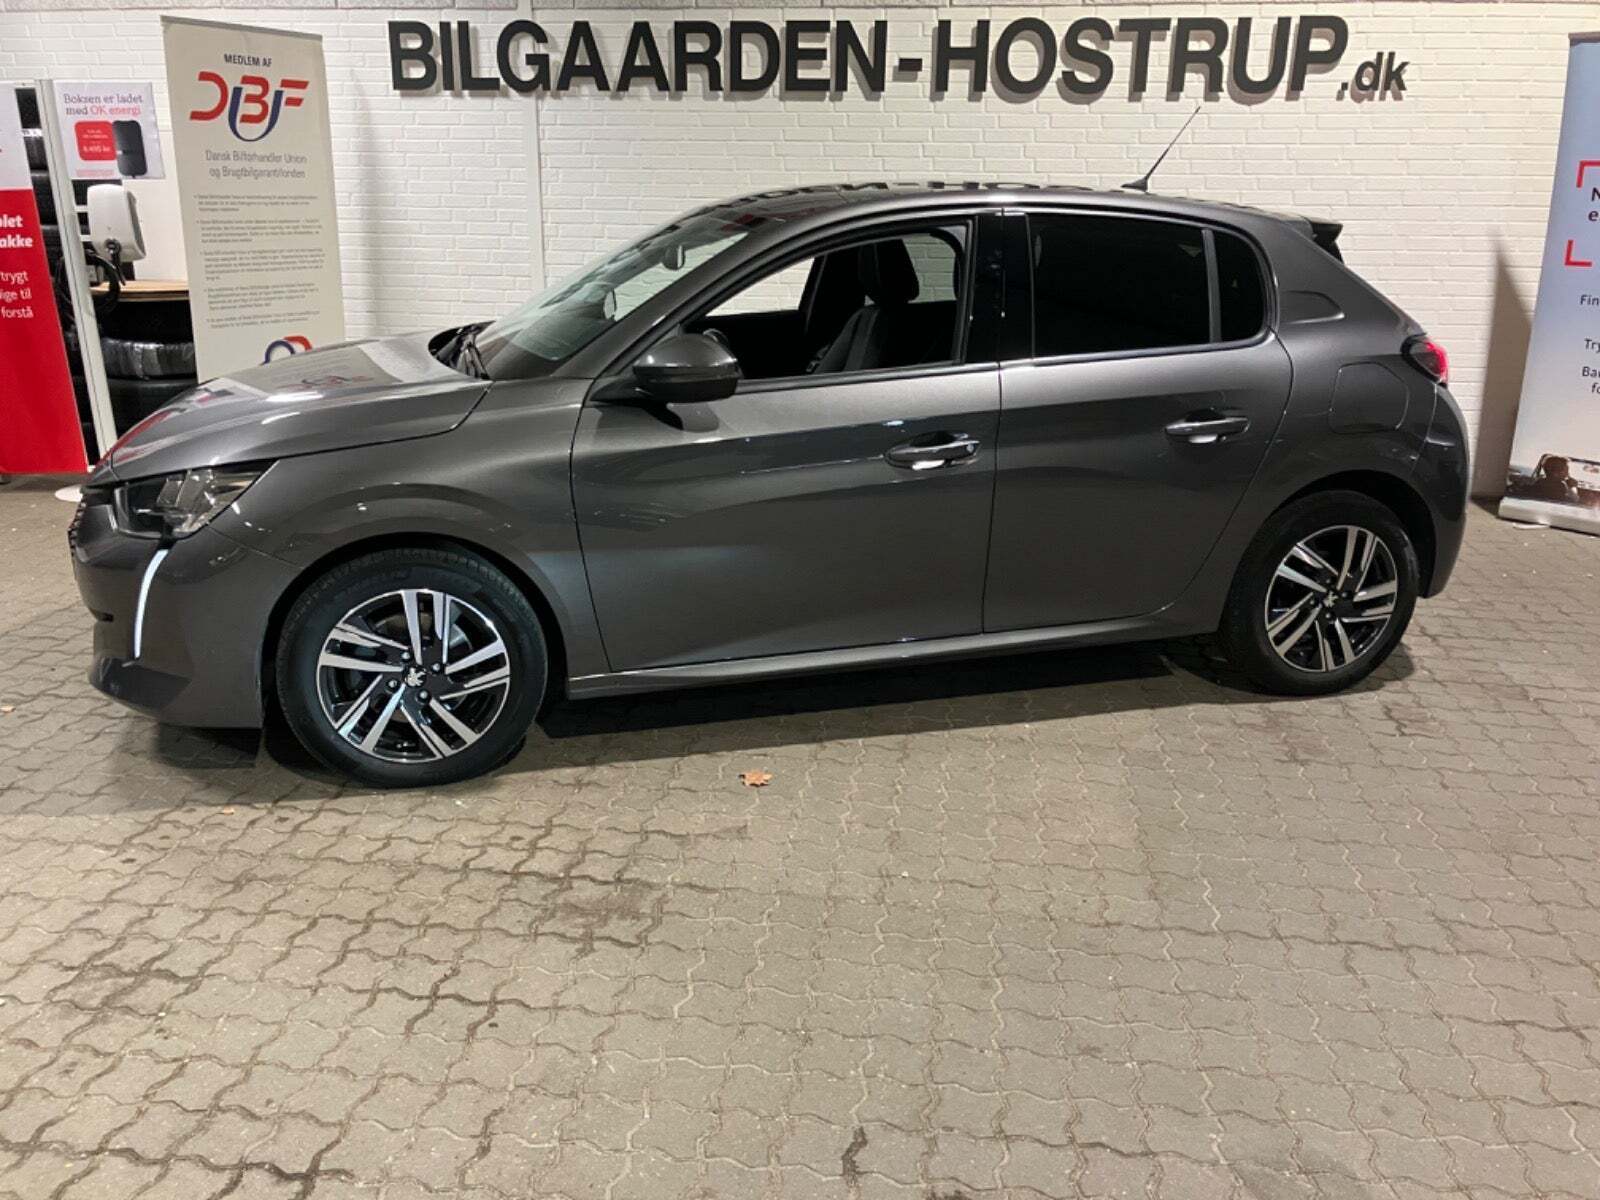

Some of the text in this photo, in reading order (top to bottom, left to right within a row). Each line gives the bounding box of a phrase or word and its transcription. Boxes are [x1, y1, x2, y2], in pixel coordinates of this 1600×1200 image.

[224, 53, 272, 68] MEDLEM AF
[64, 93, 144, 104] Boksen er ladet
[66, 105, 142, 117] med OK energi
[205, 150, 307, 164] Dansk Bilforhandler Union
[209, 168, 221, 179] og
[0, 214, 23, 228] let
[21, 288, 32, 299] til
[2, 305, 34, 318] forstå
